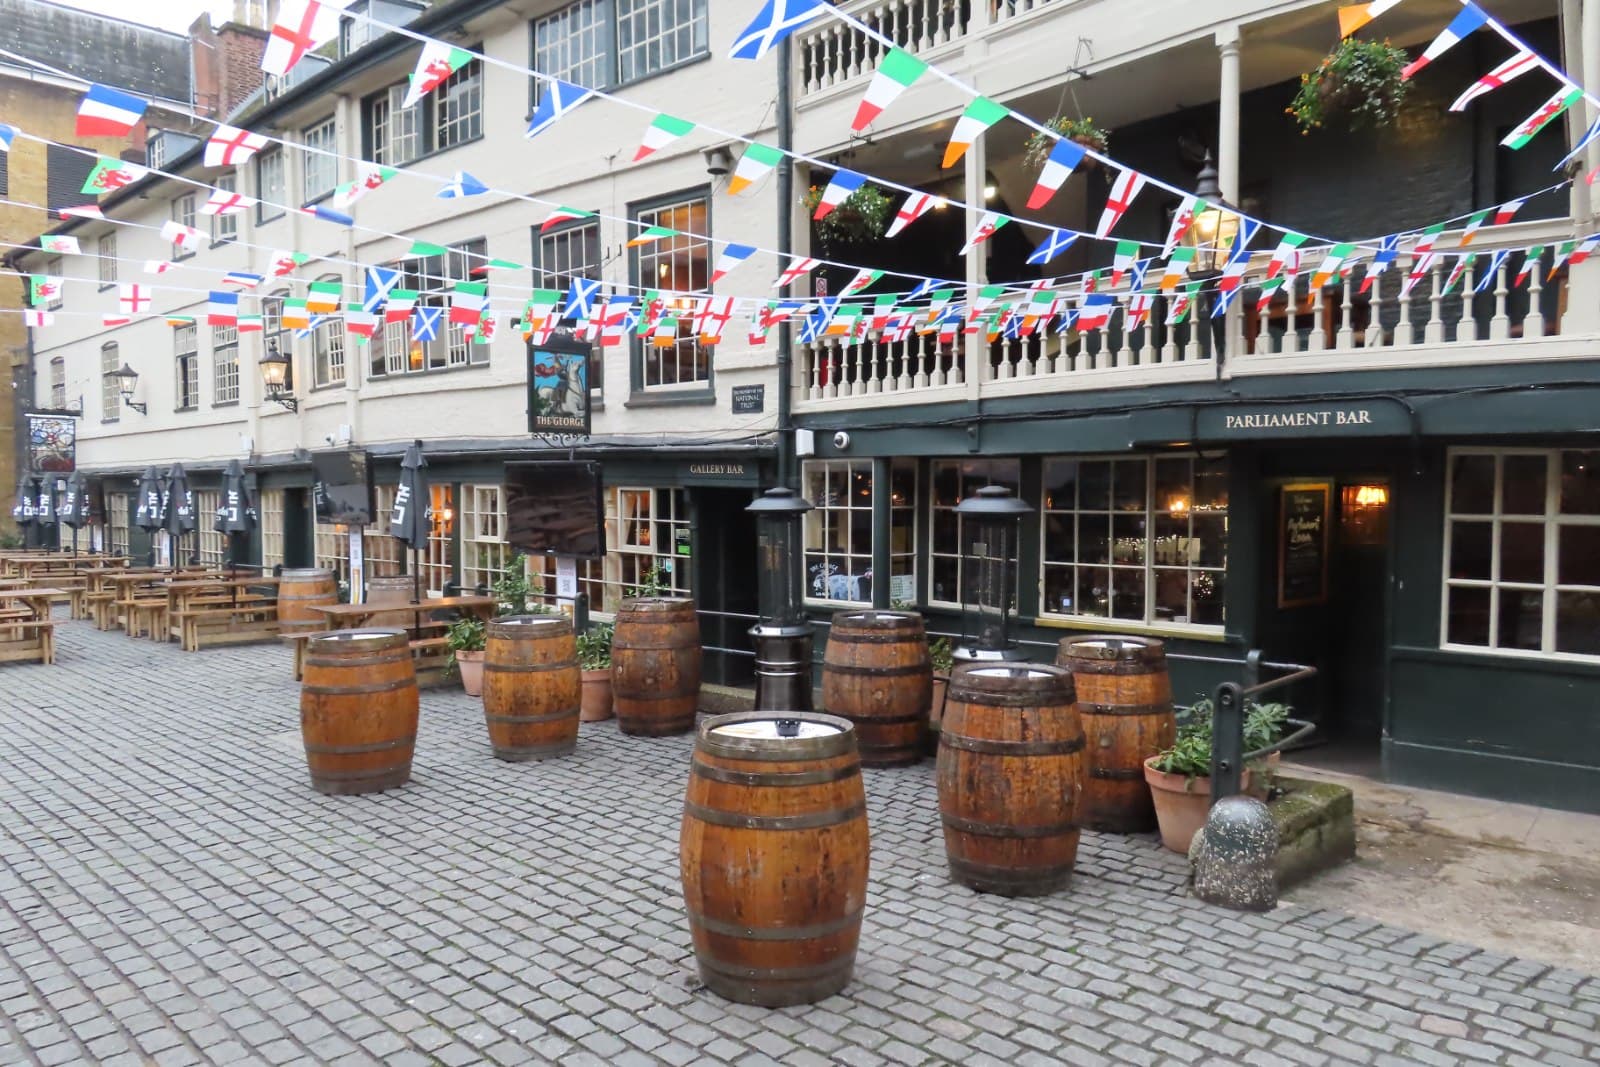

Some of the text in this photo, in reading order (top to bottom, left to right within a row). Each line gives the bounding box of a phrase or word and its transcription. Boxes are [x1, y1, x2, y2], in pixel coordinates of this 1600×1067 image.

[536, 415, 585, 427] THE GEORGE
[1226, 410, 1373, 428] PARLIAMENT BAR
[690, 464, 744, 474] GALLERY BAR
